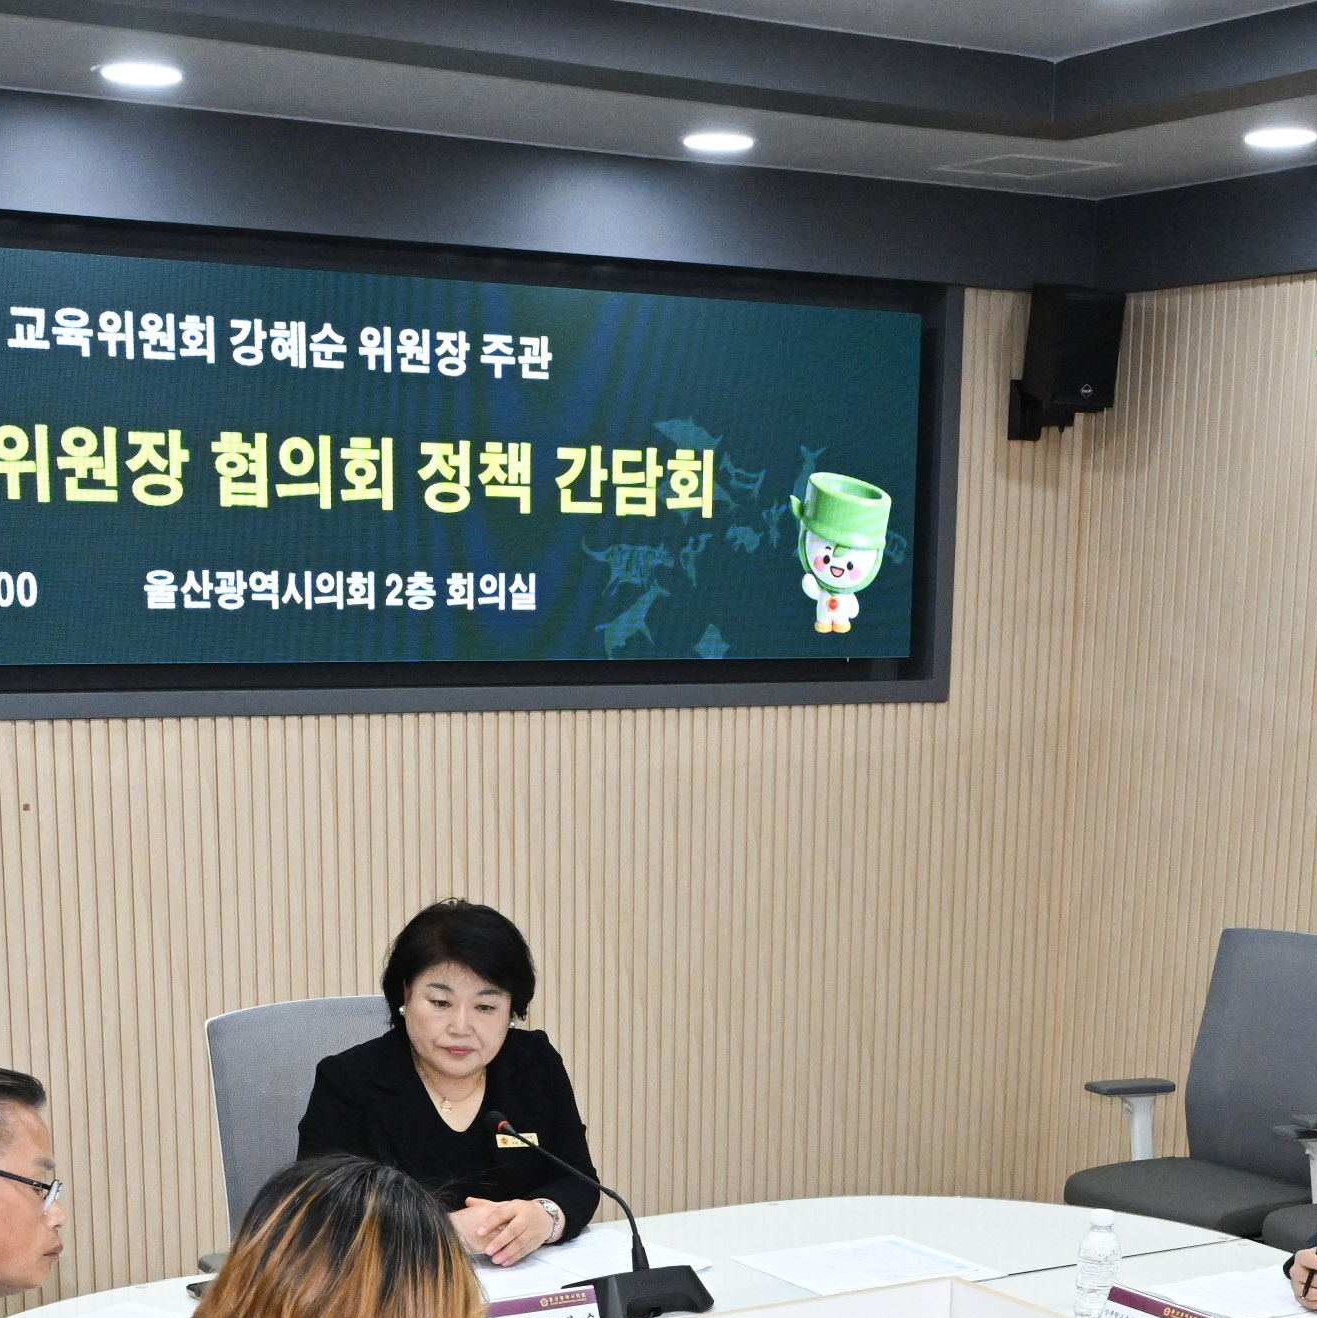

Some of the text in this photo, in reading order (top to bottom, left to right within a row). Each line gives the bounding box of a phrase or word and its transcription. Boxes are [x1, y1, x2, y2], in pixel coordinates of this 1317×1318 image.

[7, 306, 215, 363] 교육위원회
[229, 318, 347, 368] 강혜순
[358, 326, 470, 377] 위원장
[480, 333, 552, 380] 주관
[211, 431, 394, 510] 협의회
[417, 440, 532, 514] 정책
[554, 445, 714, 518] 간담회
[143, 569, 536, 611] 울산광역시의회 2층 회의실
